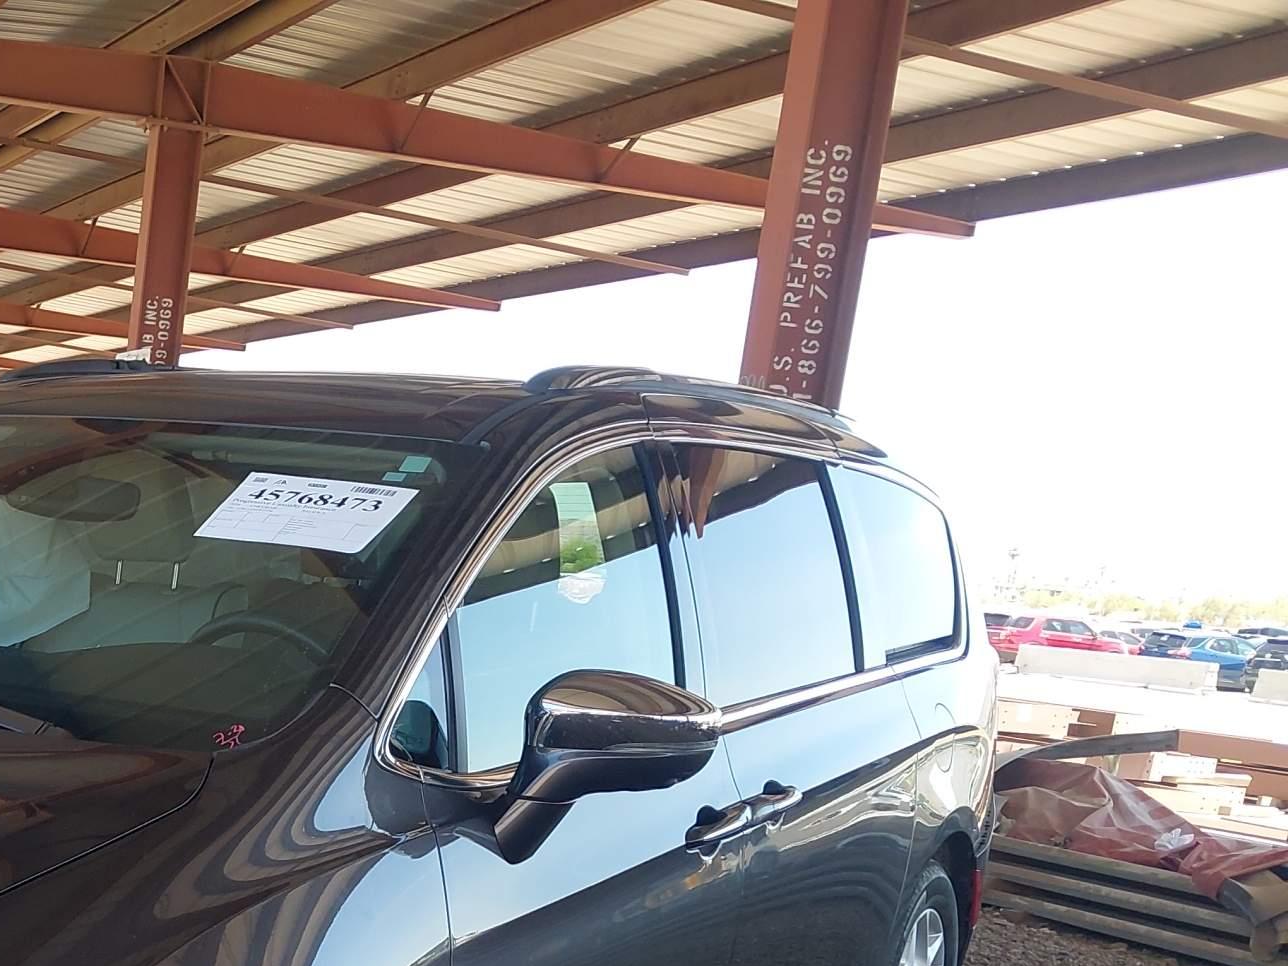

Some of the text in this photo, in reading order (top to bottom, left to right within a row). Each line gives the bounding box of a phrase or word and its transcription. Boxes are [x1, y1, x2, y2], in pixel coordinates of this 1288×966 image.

[779, 212, 817, 329] PREFAB
[800, 139, 829, 196] INC.
[792, 143, 854, 400] 1-866-799-0969
[144, 295, 159, 326] INC.
[248, 488, 383, 512] 45768473
